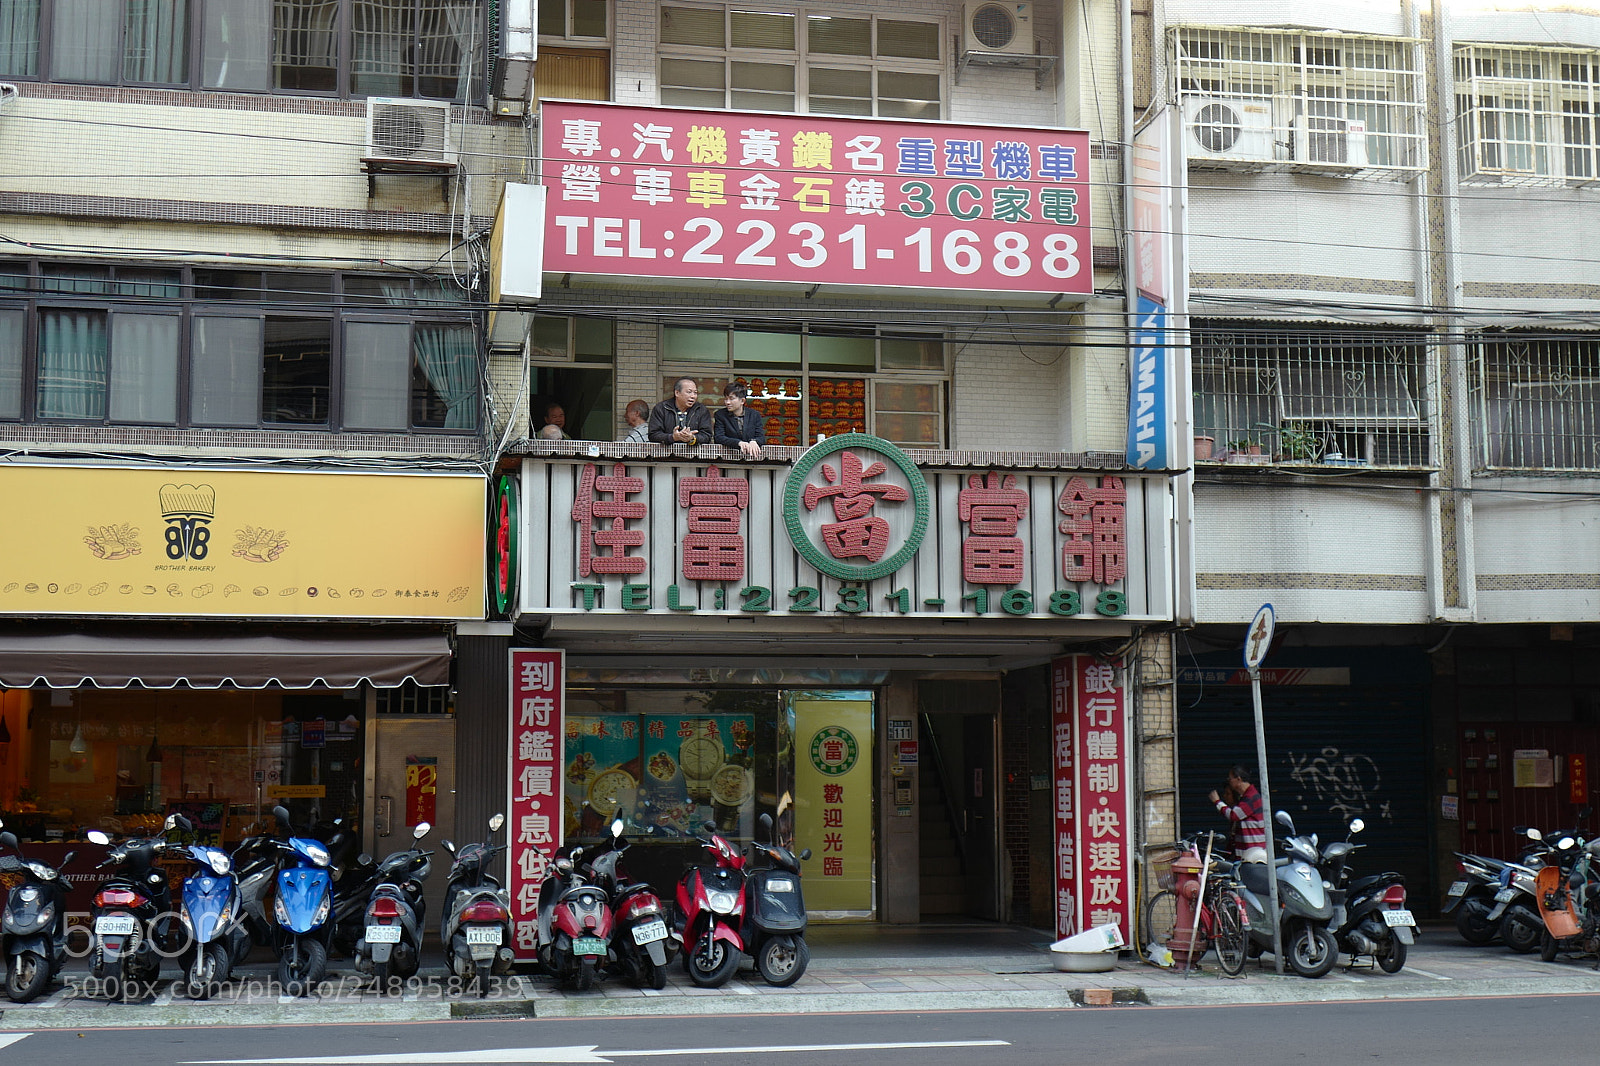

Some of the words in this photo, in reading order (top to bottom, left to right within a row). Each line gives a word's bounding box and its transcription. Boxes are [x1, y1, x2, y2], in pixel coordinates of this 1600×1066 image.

[632, 122, 674, 207] 汽車
[686, 124, 728, 210] 機車
[738, 128, 781, 212] 黃金
[791, 130, 833, 214] 鑽石
[844, 134, 886, 218] 名錶
[895, 136, 1078, 183] 重型機車
[899, 181, 1078, 226] 3C家電
[555, 214, 1081, 279] TEL:2231-1688
[1136, 306, 1160, 469] YAMAHA
[154, 564, 186, 572] BROTHER
[188, 565, 216, 573] BAKERY
[1184, 671, 1226, 682] 世界品質
[1238, 671, 1278, 682] YAAHA
[824, 740, 843, 760] 當
[894, 728, 911, 738] 111
[822, 783, 843, 877] 歡迎光臨
[1054, 666, 1076, 938] 計程車借款
[64, 874, 97, 882] OTHER
